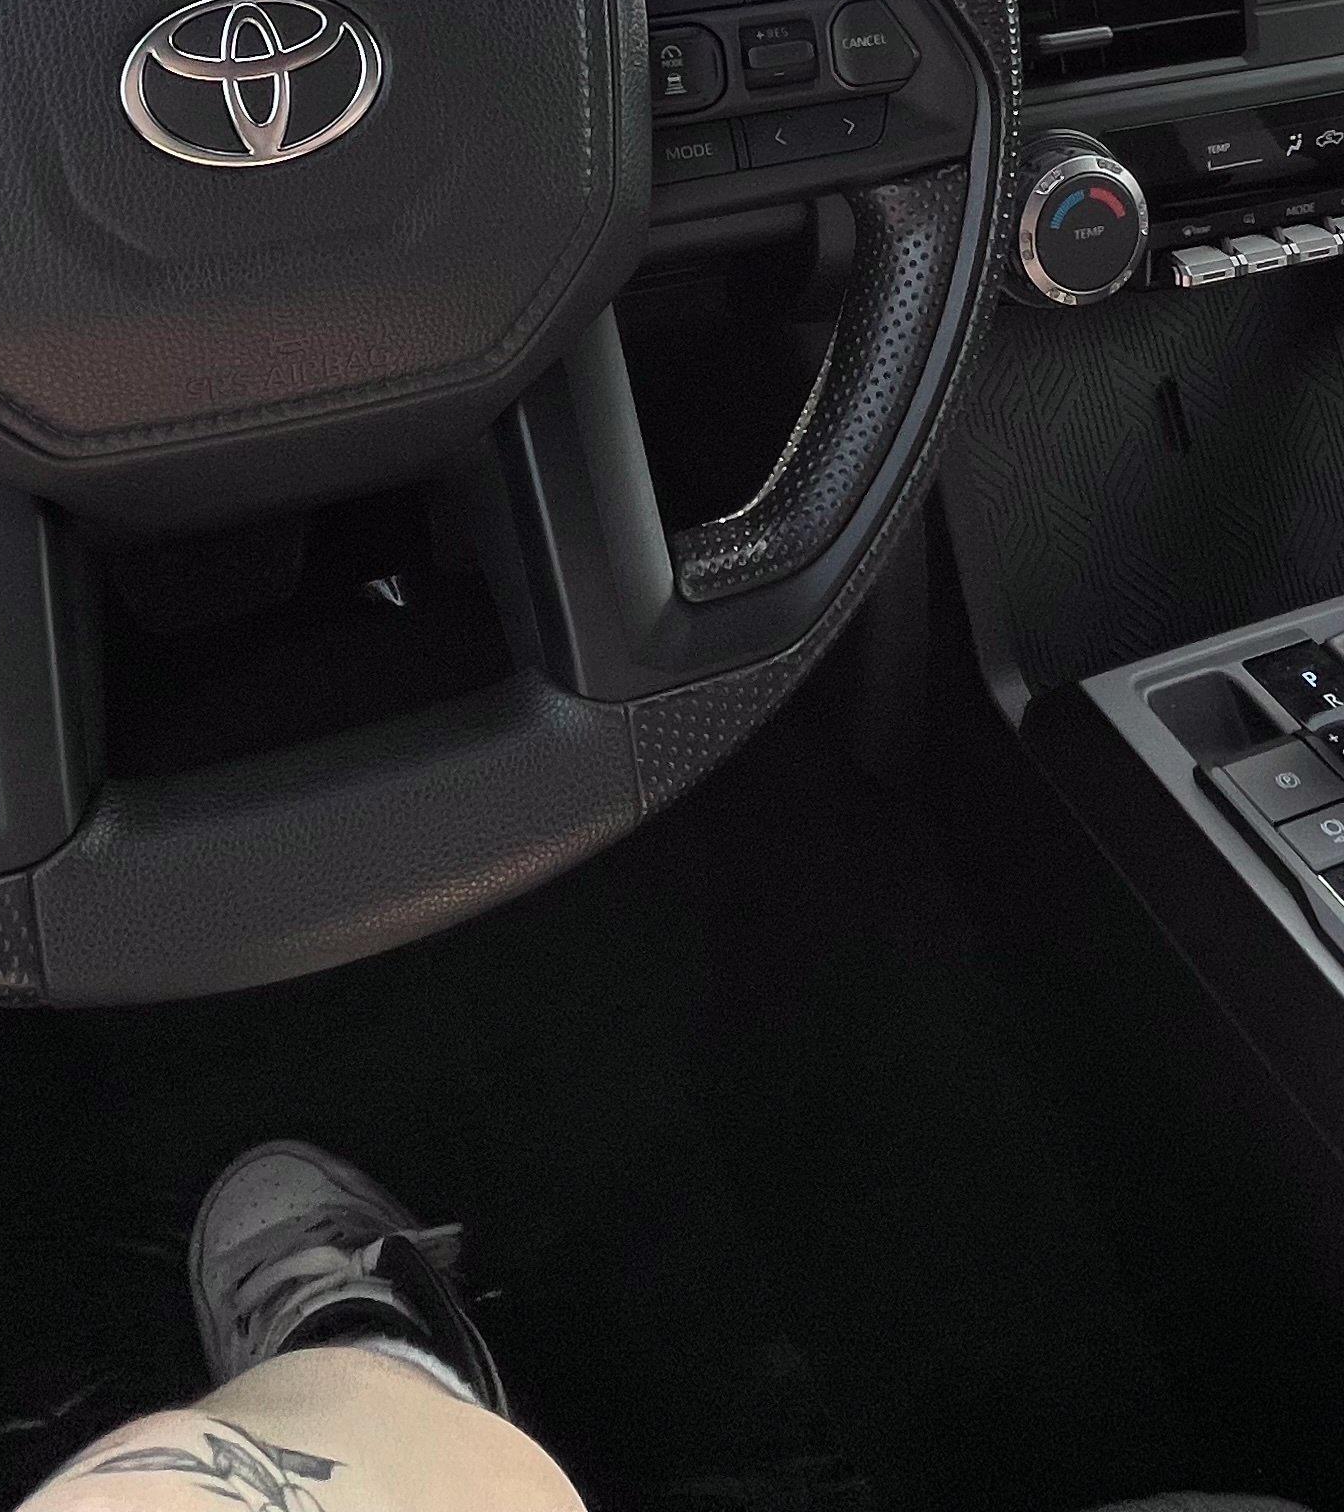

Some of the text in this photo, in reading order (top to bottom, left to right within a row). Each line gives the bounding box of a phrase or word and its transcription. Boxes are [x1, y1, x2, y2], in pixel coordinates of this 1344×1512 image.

[842, 33, 887, 50] CANCEL
[664, 142, 714, 161] MODE
[1207, 142, 1231, 156] TEMP
[1286, 201, 1316, 217] MODE
[1074, 225, 1105, 240] TEMP
[1302, 670, 1320, 688] P
[1323, 692, 1344, 709] R
